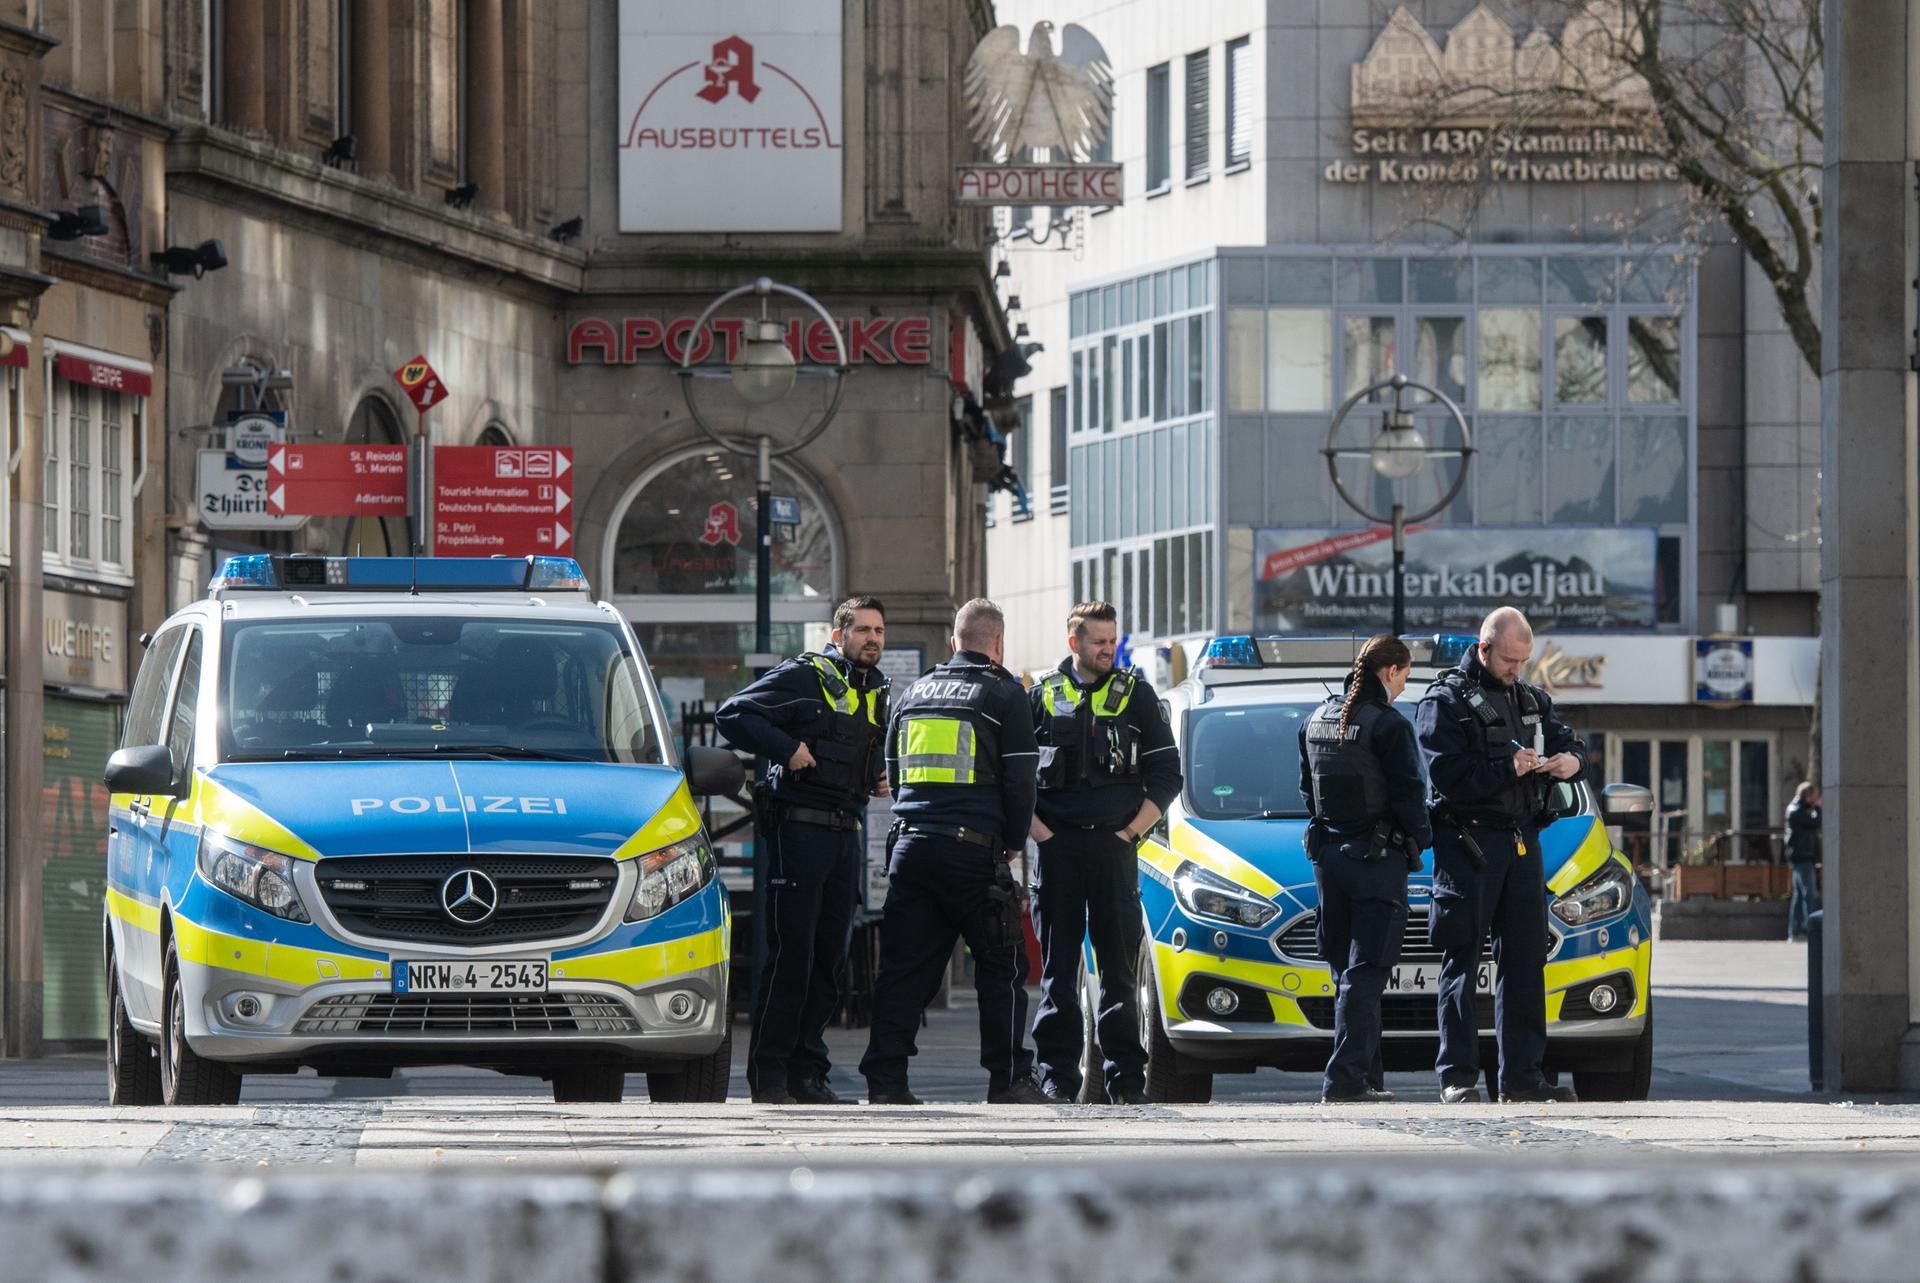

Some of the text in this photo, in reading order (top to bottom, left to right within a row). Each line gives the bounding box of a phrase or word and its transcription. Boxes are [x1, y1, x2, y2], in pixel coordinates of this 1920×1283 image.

[637, 127, 822, 149] AUSBÜTTELS
[1353, 130, 1645, 153] Seit 1430 Stammhau
[1324, 160, 1371, 182] der
[1490, 159, 1680, 182] Privatbrauere
[958, 171, 1118, 198] APOTHEKE
[350, 451, 403, 461] St. Reinoldi
[370, 464, 403, 473] Marien
[236, 474, 268, 492] De
[439, 486, 529, 497] Tourist-Information
[355, 494, 404, 504] Adlerturm
[438, 503, 483, 513] Deutsches
[453, 523, 476, 533] Petri
[438, 535, 504, 547] Propsteikirche
[1306, 563, 1605, 605] Winterkabeljau
[46, 617, 112, 663] WEMPE
[911, 682, 977, 700] POLIZEI
[351, 795, 567, 815] POLIZEI
[408, 964, 451, 989] NRW
